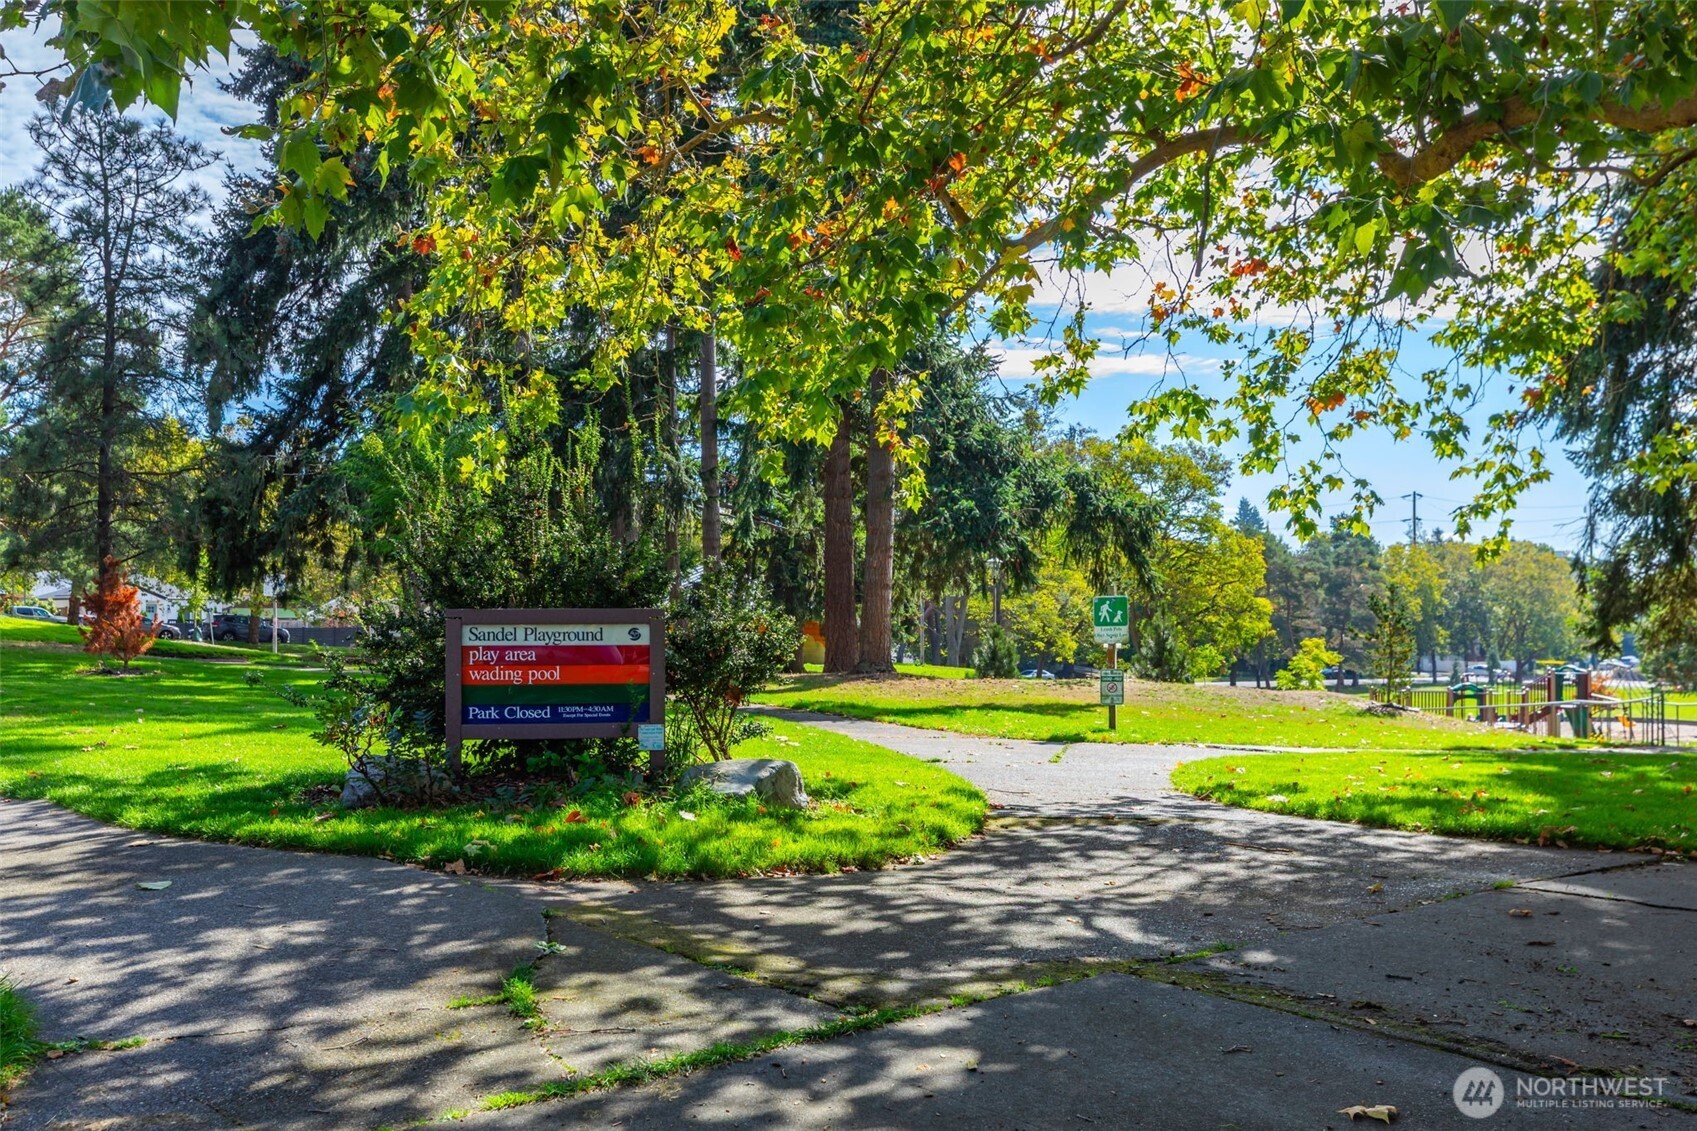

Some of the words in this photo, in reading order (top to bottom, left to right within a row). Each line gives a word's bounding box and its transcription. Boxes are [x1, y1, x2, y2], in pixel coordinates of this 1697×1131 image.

[468, 626, 517, 642] Sandel
[523, 626, 604, 646] Playground
[469, 646, 500, 665] play
[504, 651, 537, 662] area
[468, 665, 523, 685] wading
[528, 665, 561, 685] pool
[468, 707, 500, 720] Park
[504, 705, 551, 719] Closed
